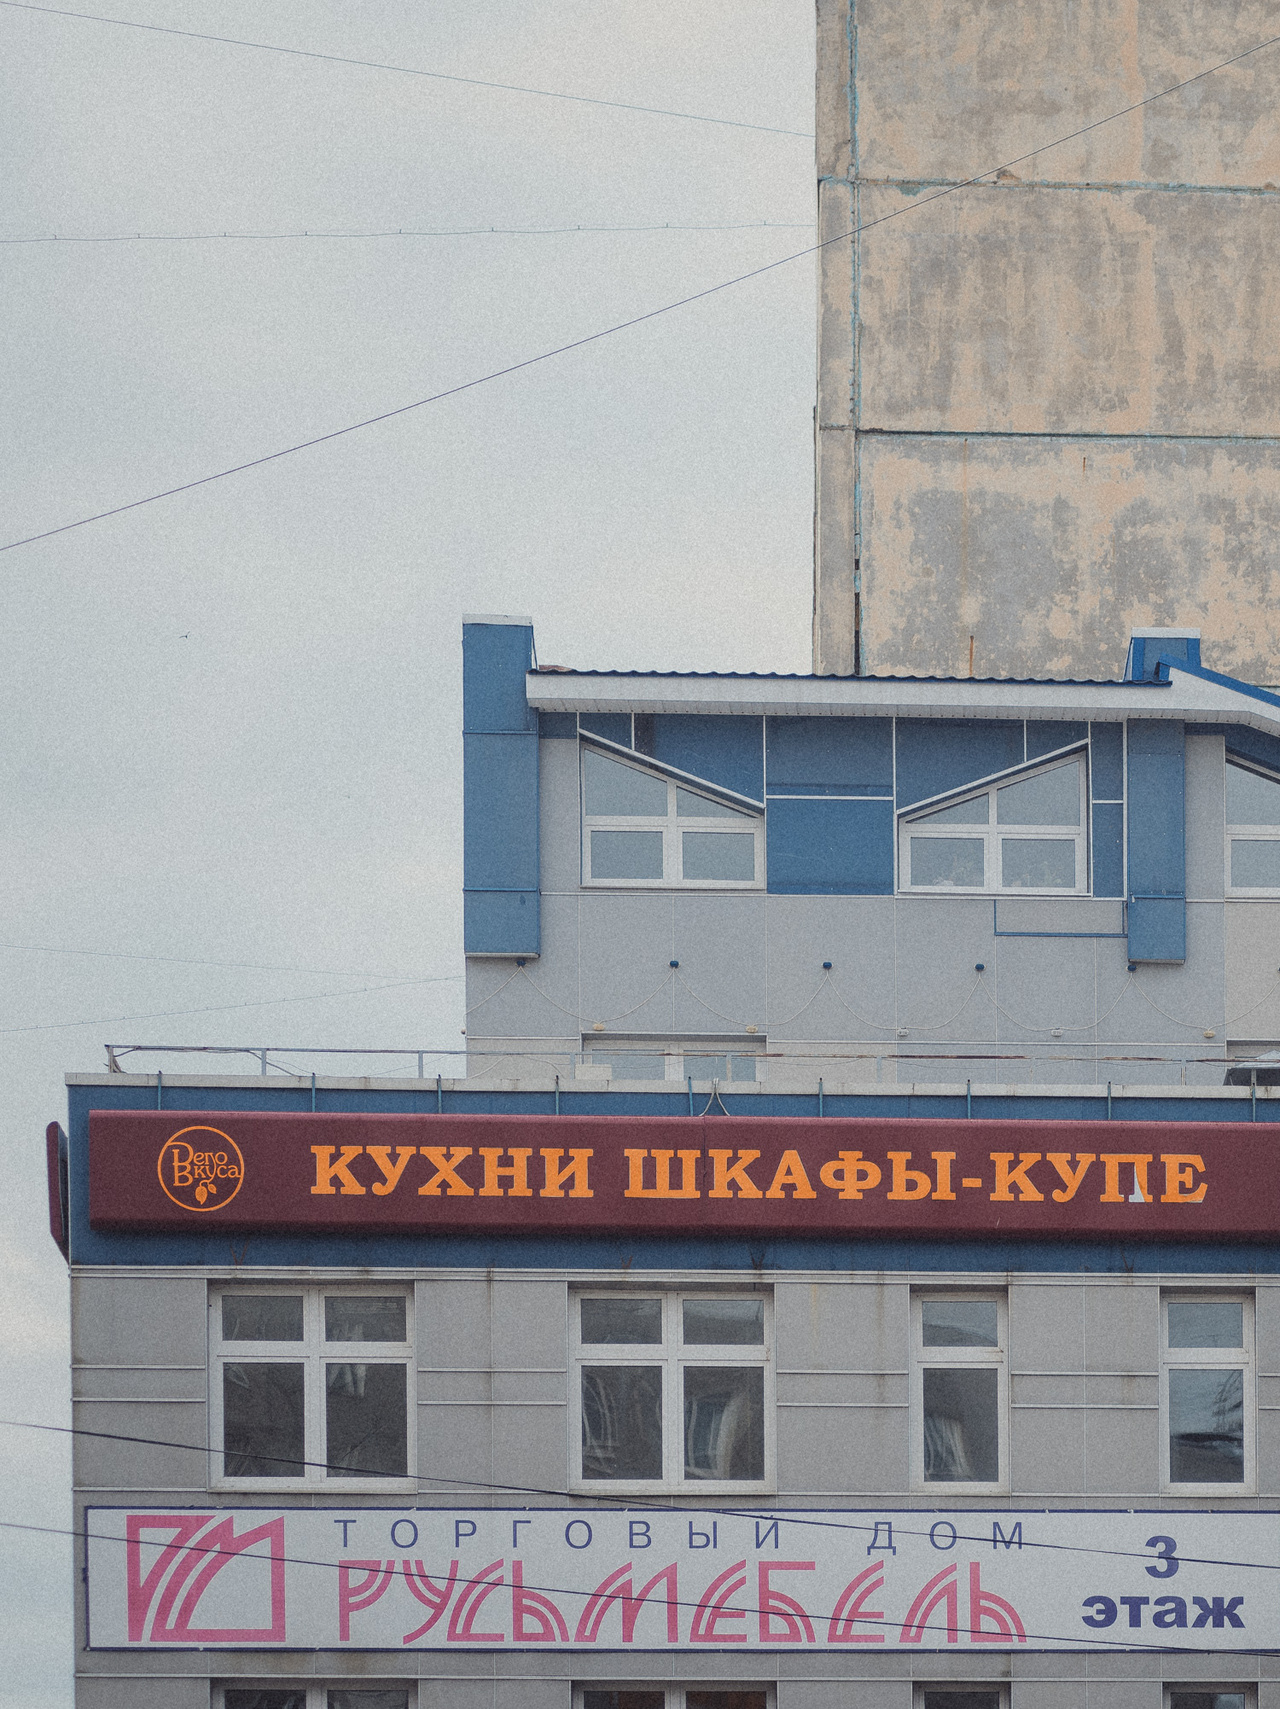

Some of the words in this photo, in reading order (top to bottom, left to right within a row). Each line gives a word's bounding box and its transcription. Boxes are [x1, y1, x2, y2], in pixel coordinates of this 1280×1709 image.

[309, 1144, 595, 1199] КУХНИ
[623, 1147, 1209, 1205] ШКАФЫ-КУПЕ
[334, 1514, 779, 1549] ТОРГОВЫЙ
[866, 1520, 1025, 1556] ДОМ
[1144, 1535, 1180, 1579] 3
[1081, 1595, 1246, 1629] этаж
